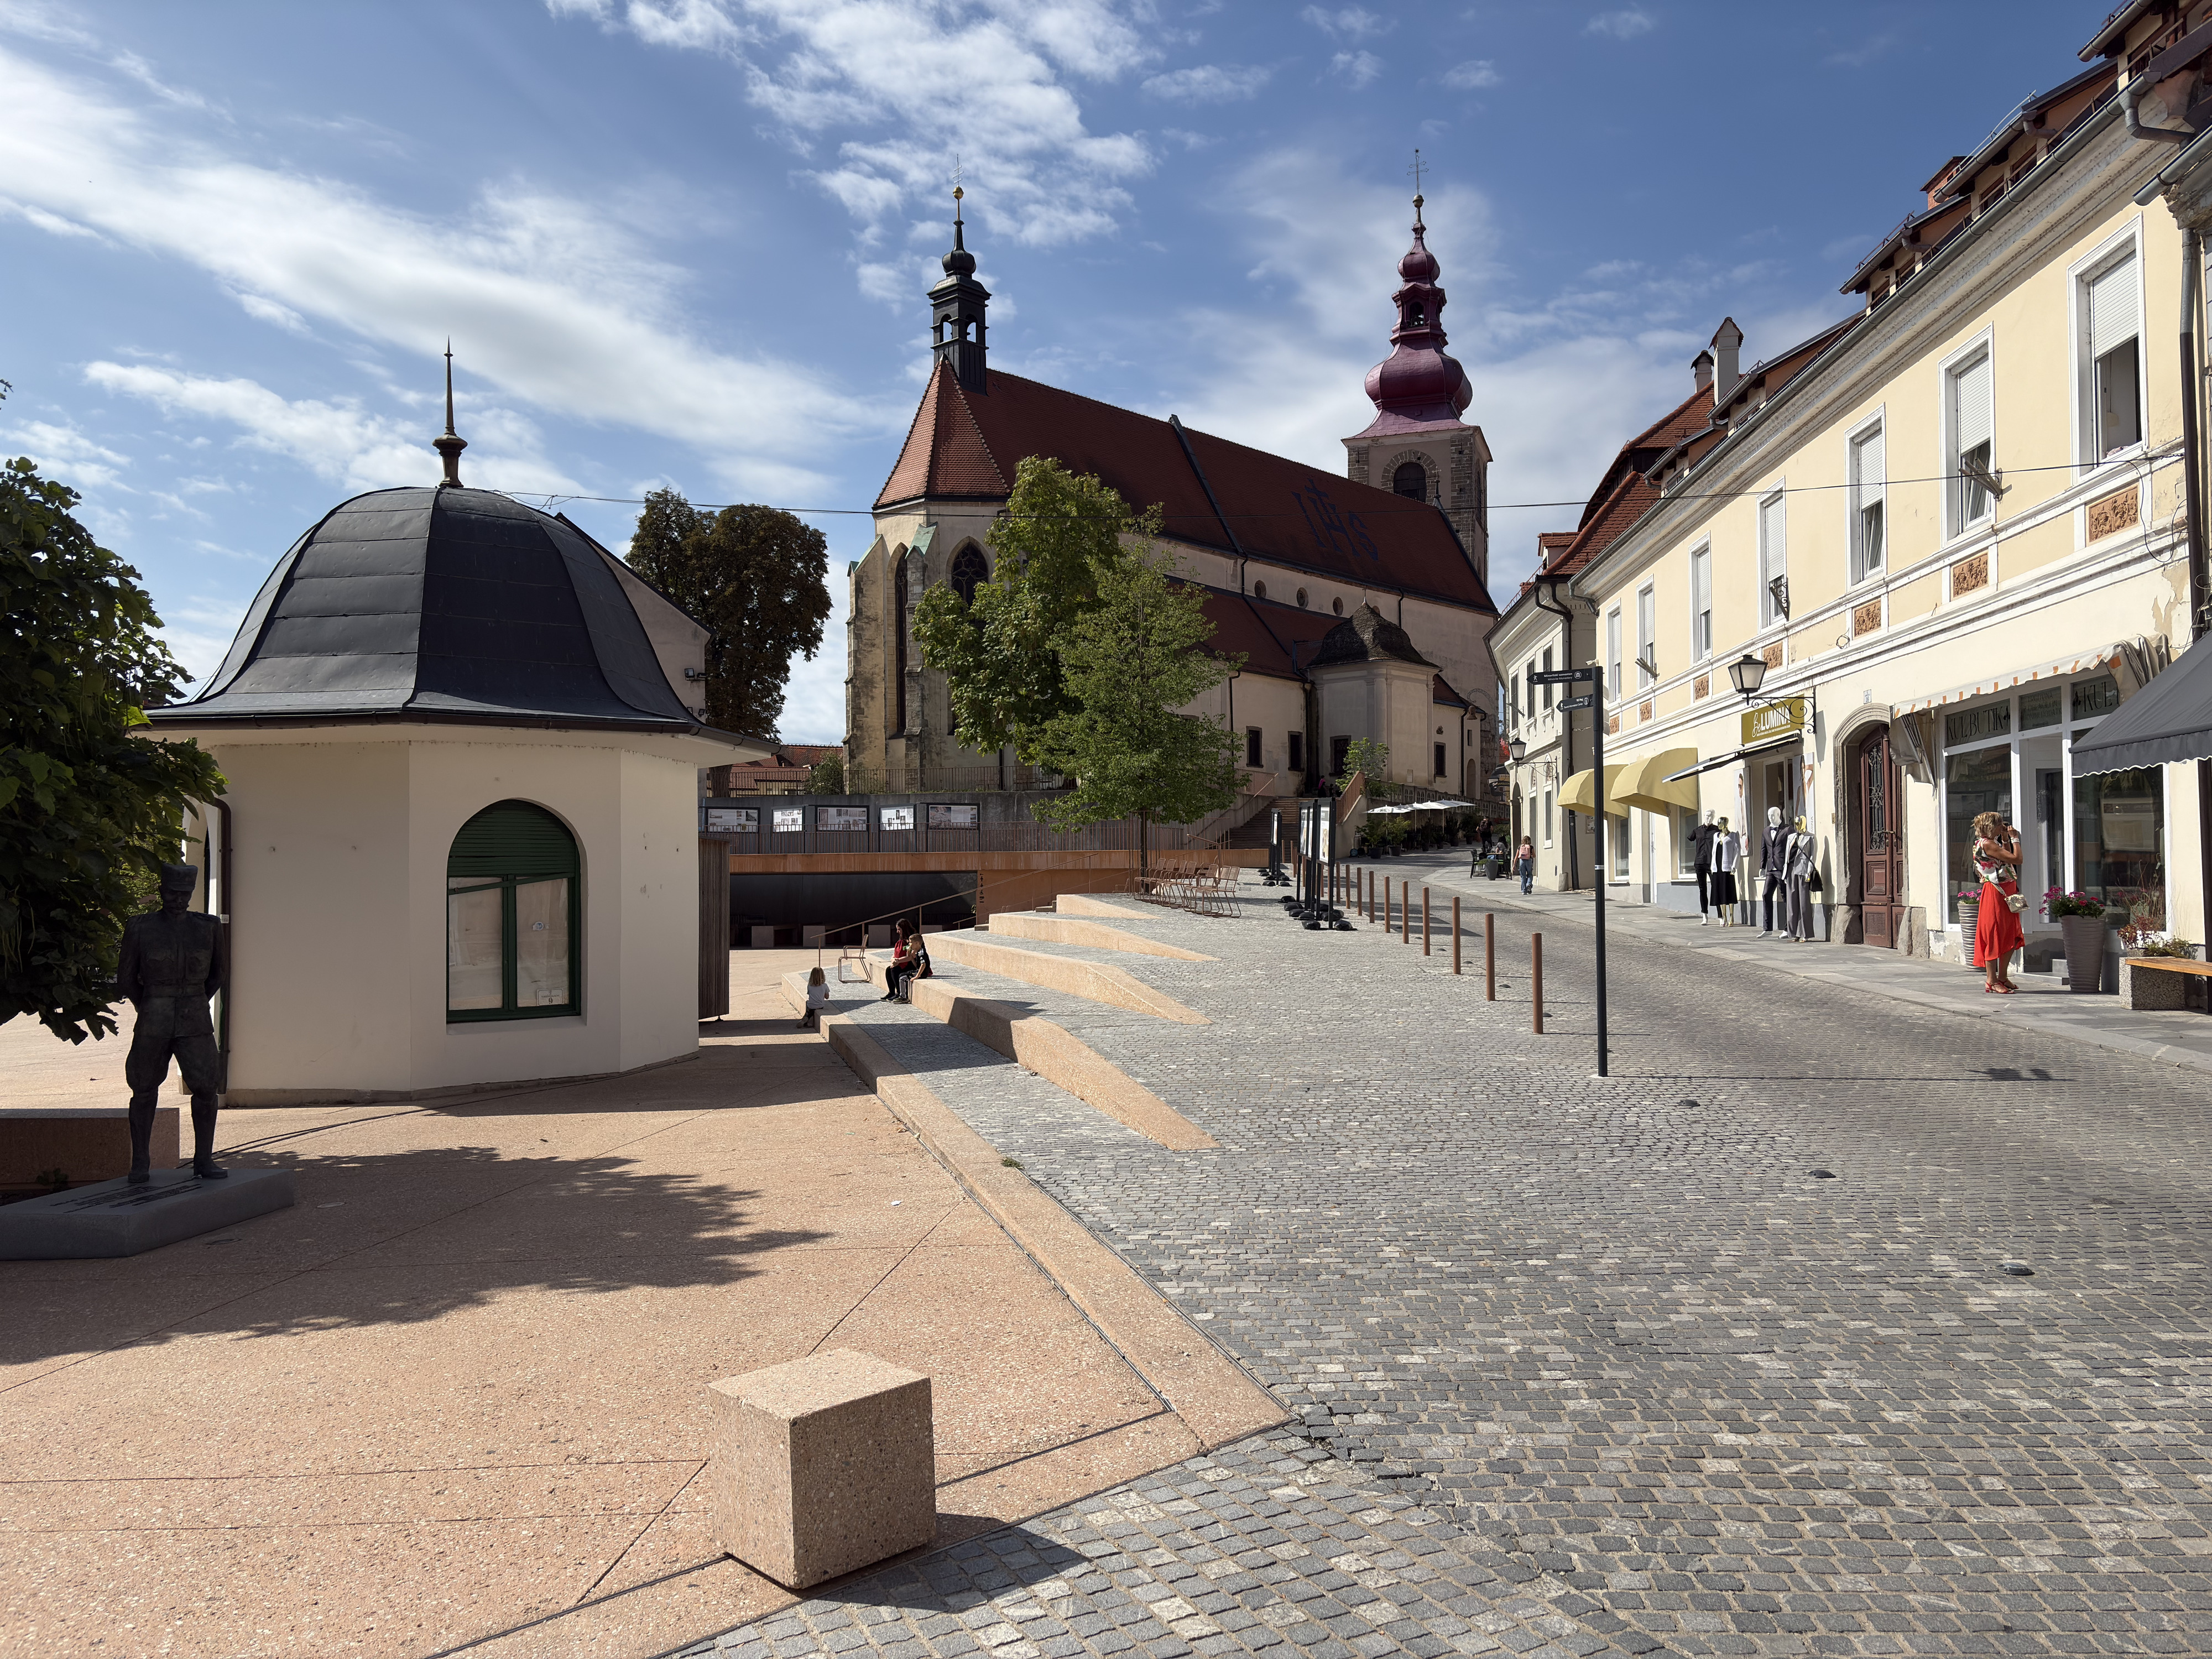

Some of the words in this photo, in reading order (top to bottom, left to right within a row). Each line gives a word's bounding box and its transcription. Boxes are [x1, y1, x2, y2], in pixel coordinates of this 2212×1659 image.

[2084, 681, 2112, 712] KUL
[1947, 716, 1968, 742] KUL
[1969, 706, 2004, 737] BUTIK
